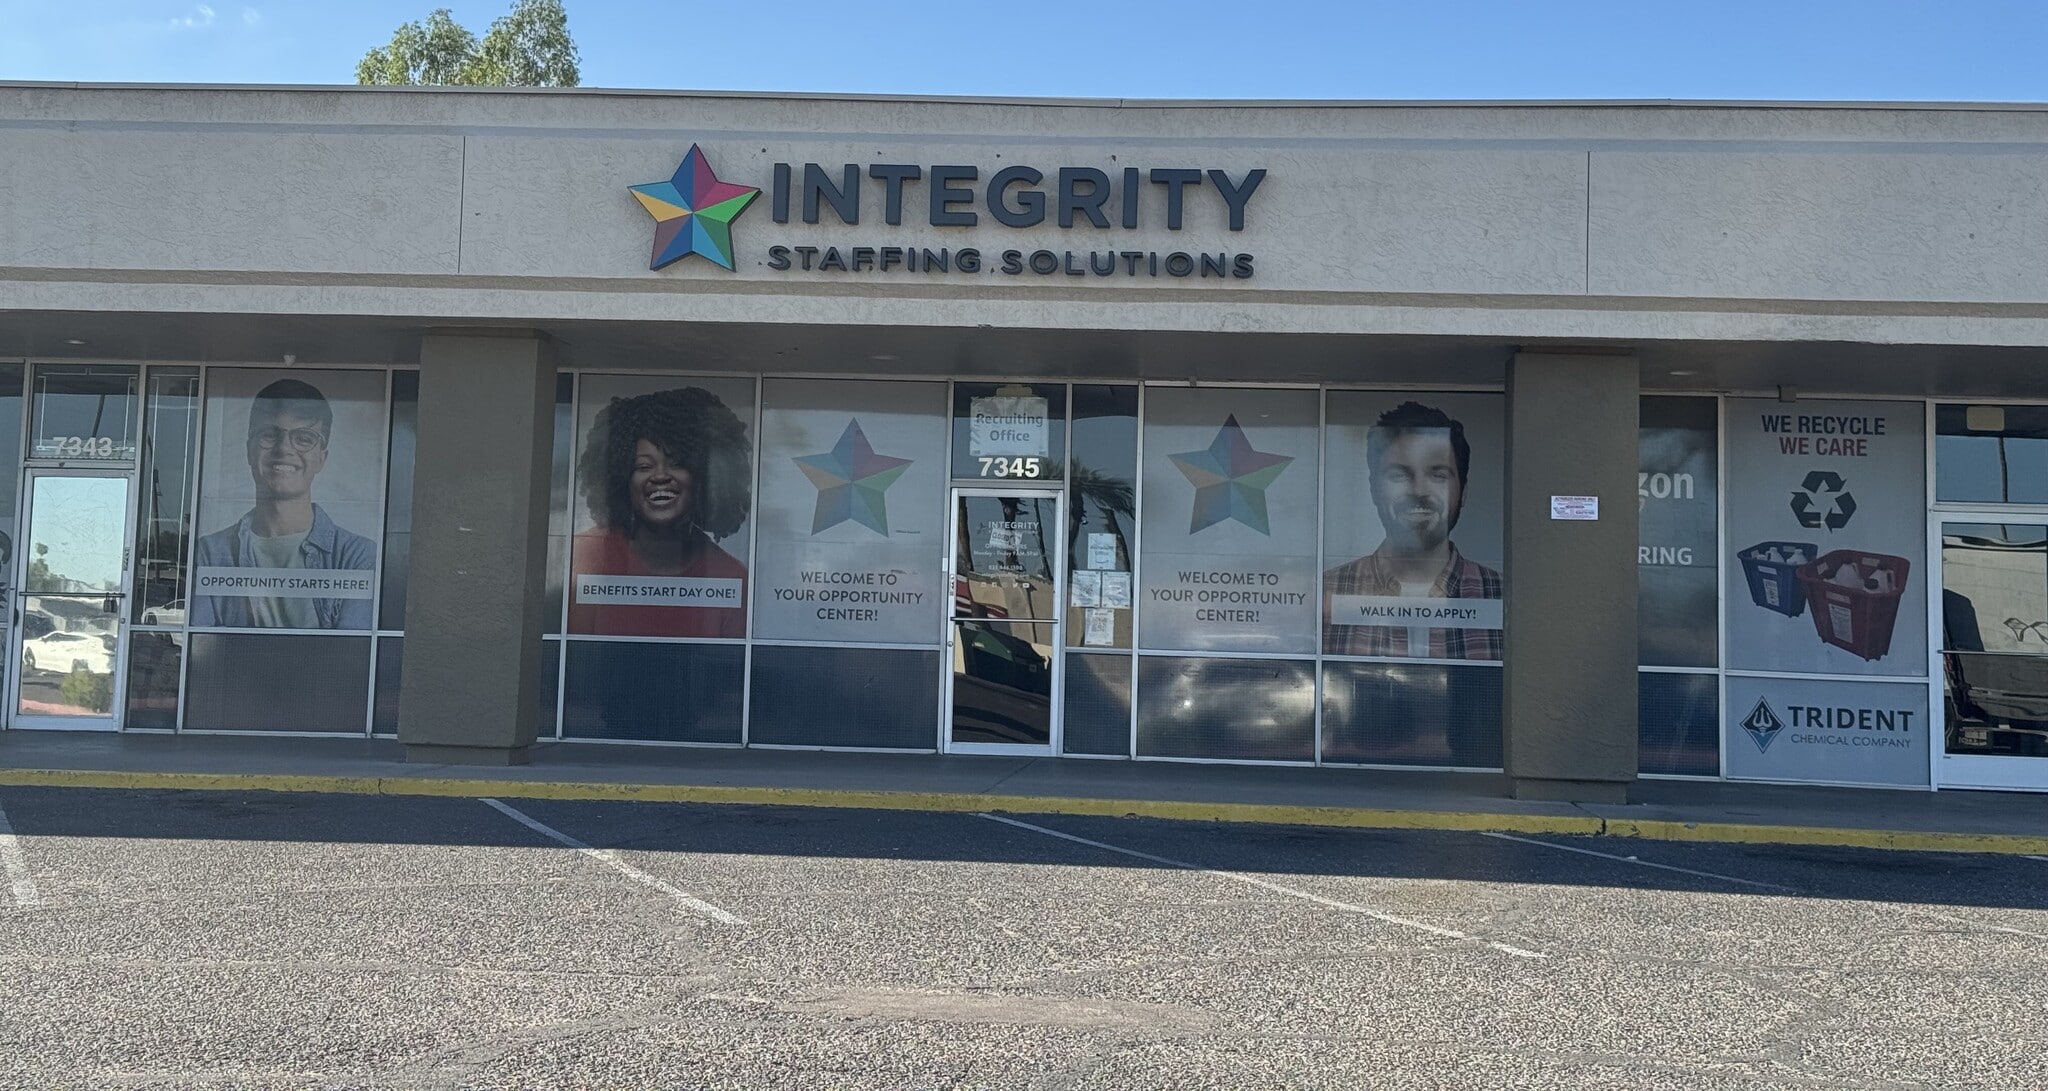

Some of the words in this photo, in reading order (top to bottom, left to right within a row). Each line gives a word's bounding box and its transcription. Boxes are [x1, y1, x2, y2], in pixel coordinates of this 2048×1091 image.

[772, 163, 1267, 231] INTEGRITY
[767, 245, 982, 274] STAFFING
[1001, 249, 1256, 279] SOLUTIONS
[975, 412, 1044, 428] Recruiting
[1762, 415, 1789, 432] WE
[1798, 416, 1886, 435] RECYCLE
[989, 429, 1031, 443] Office
[53, 436, 113, 457] 7343
[1780, 436, 1808, 455] WE
[1815, 438, 1868, 457] CARE
[978, 457, 1040, 478] 7345
[988, 521, 1039, 530] INTEGRITY
[200, 576, 286, 589] OPPORTUNITY
[288, 578, 331, 590] STARTS
[333, 579, 370, 591] HERE!
[801, 571, 876, 586] WELCOME
[878, 573, 898, 586] TO
[1178, 571, 1253, 587] WELCOME
[1258, 573, 1279, 586] TO
[583, 585, 639, 597] BENEFITS
[640, 586, 676, 598] START
[679, 587, 703, 599] DAY
[705, 588, 737, 599] ONE!
[774, 589, 815, 602] YOUR
[819, 590, 924, 605] OPPORTUNITY
[1150, 588, 1194, 602] YOUR
[1197, 591, 1306, 606] OPPORTUNITY
[816, 607, 879, 622] CENTER!
[1195, 608, 1260, 623] CENTER!
[1360, 605, 1395, 617] WALK
[1397, 606, 1412, 617] IN
[1414, 606, 1432, 617] TO
[1434, 607, 1477, 619] APPLY!
[1788, 705, 1913, 732] TRIDENT
[1791, 733, 1849, 746] CHEMICAL
[1853, 734, 1911, 750] COMPANY
